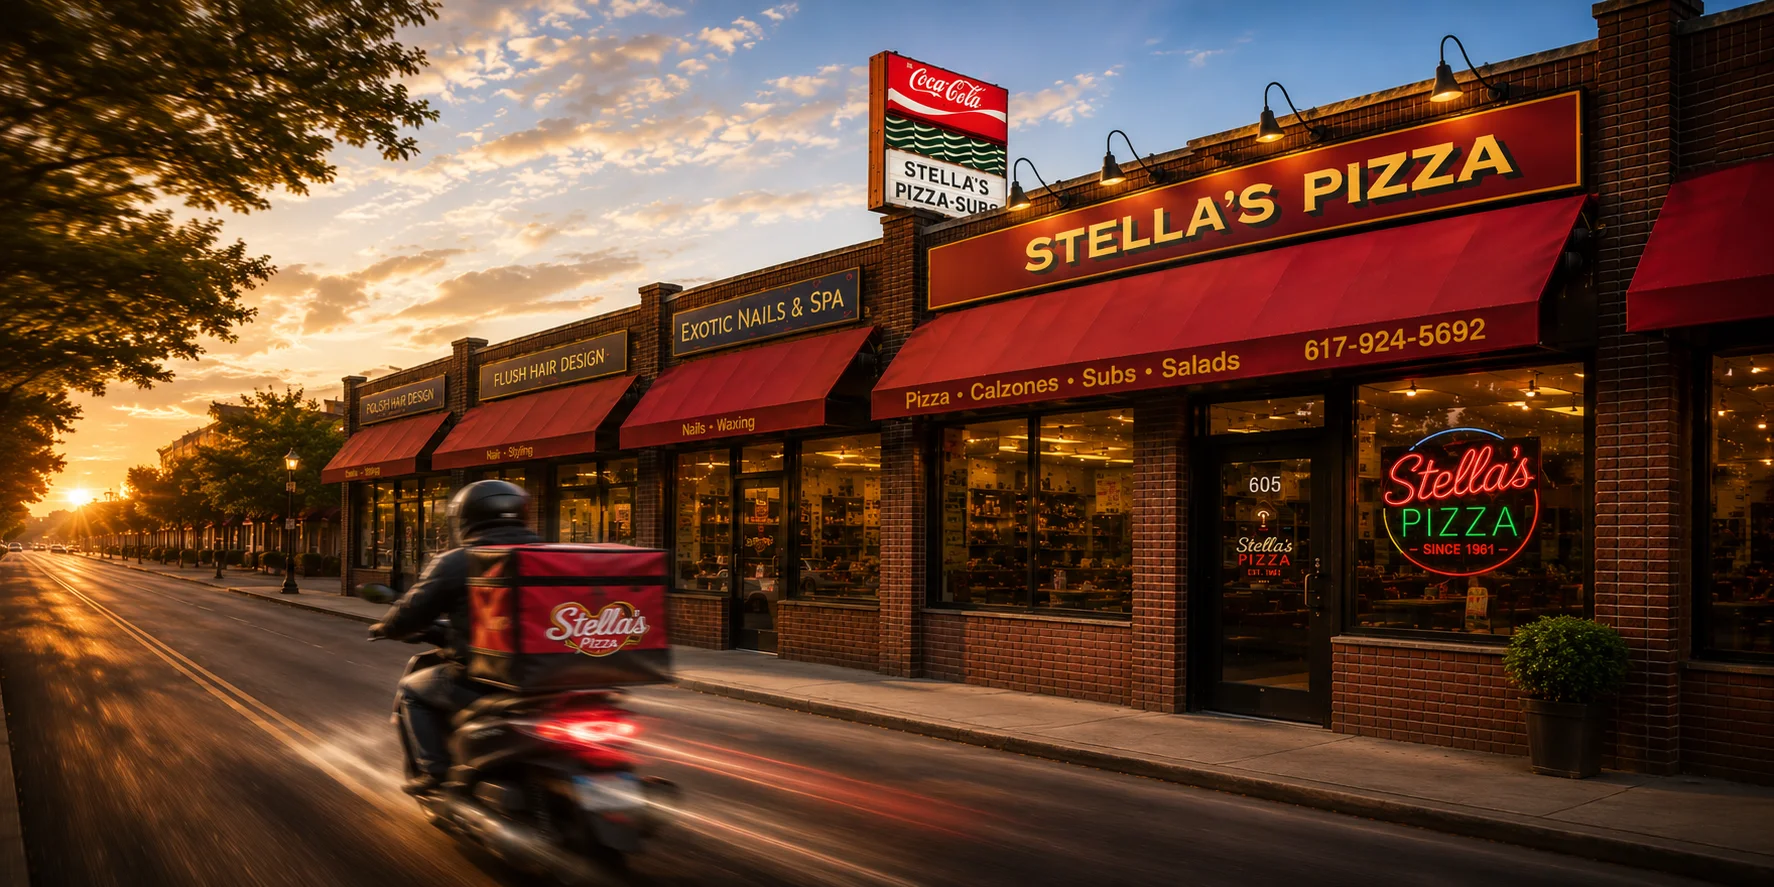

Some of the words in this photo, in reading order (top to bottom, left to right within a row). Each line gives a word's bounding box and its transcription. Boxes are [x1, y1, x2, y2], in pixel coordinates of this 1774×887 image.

[909, 68, 986, 108] Coca-Cola
[1025, 183, 1277, 272] STELLA'S
[1303, 134, 1513, 213] PIZZA
[791, 297, 803, 318] &
[494, 366, 527, 388] FLUSH
[530, 360, 557, 380] HAIR
[561, 348, 605, 373] DESIGN
[905, 391, 951, 410] Pizza
[970, 375, 1060, 401] Calzones
[1082, 367, 1138, 388] Subs
[1161, 350, 1241, 379] Salads
[1303, 316, 1487, 362] 617-924-5692
[682, 422, 706, 436] Nails
[716, 416, 755, 432] Waxing
[1249, 476, 1281, 493] 605
[1384, 445, 1536, 506] Stella's
[1402, 506, 1518, 537] PIZZA
[1236, 536, 1293, 553] Stella's
[1238, 554, 1291, 566] PIZZA
[1423, 543, 1461, 555] SINCE
[1466, 543, 1494, 555] 1961
[545, 607, 649, 641] Stella's
